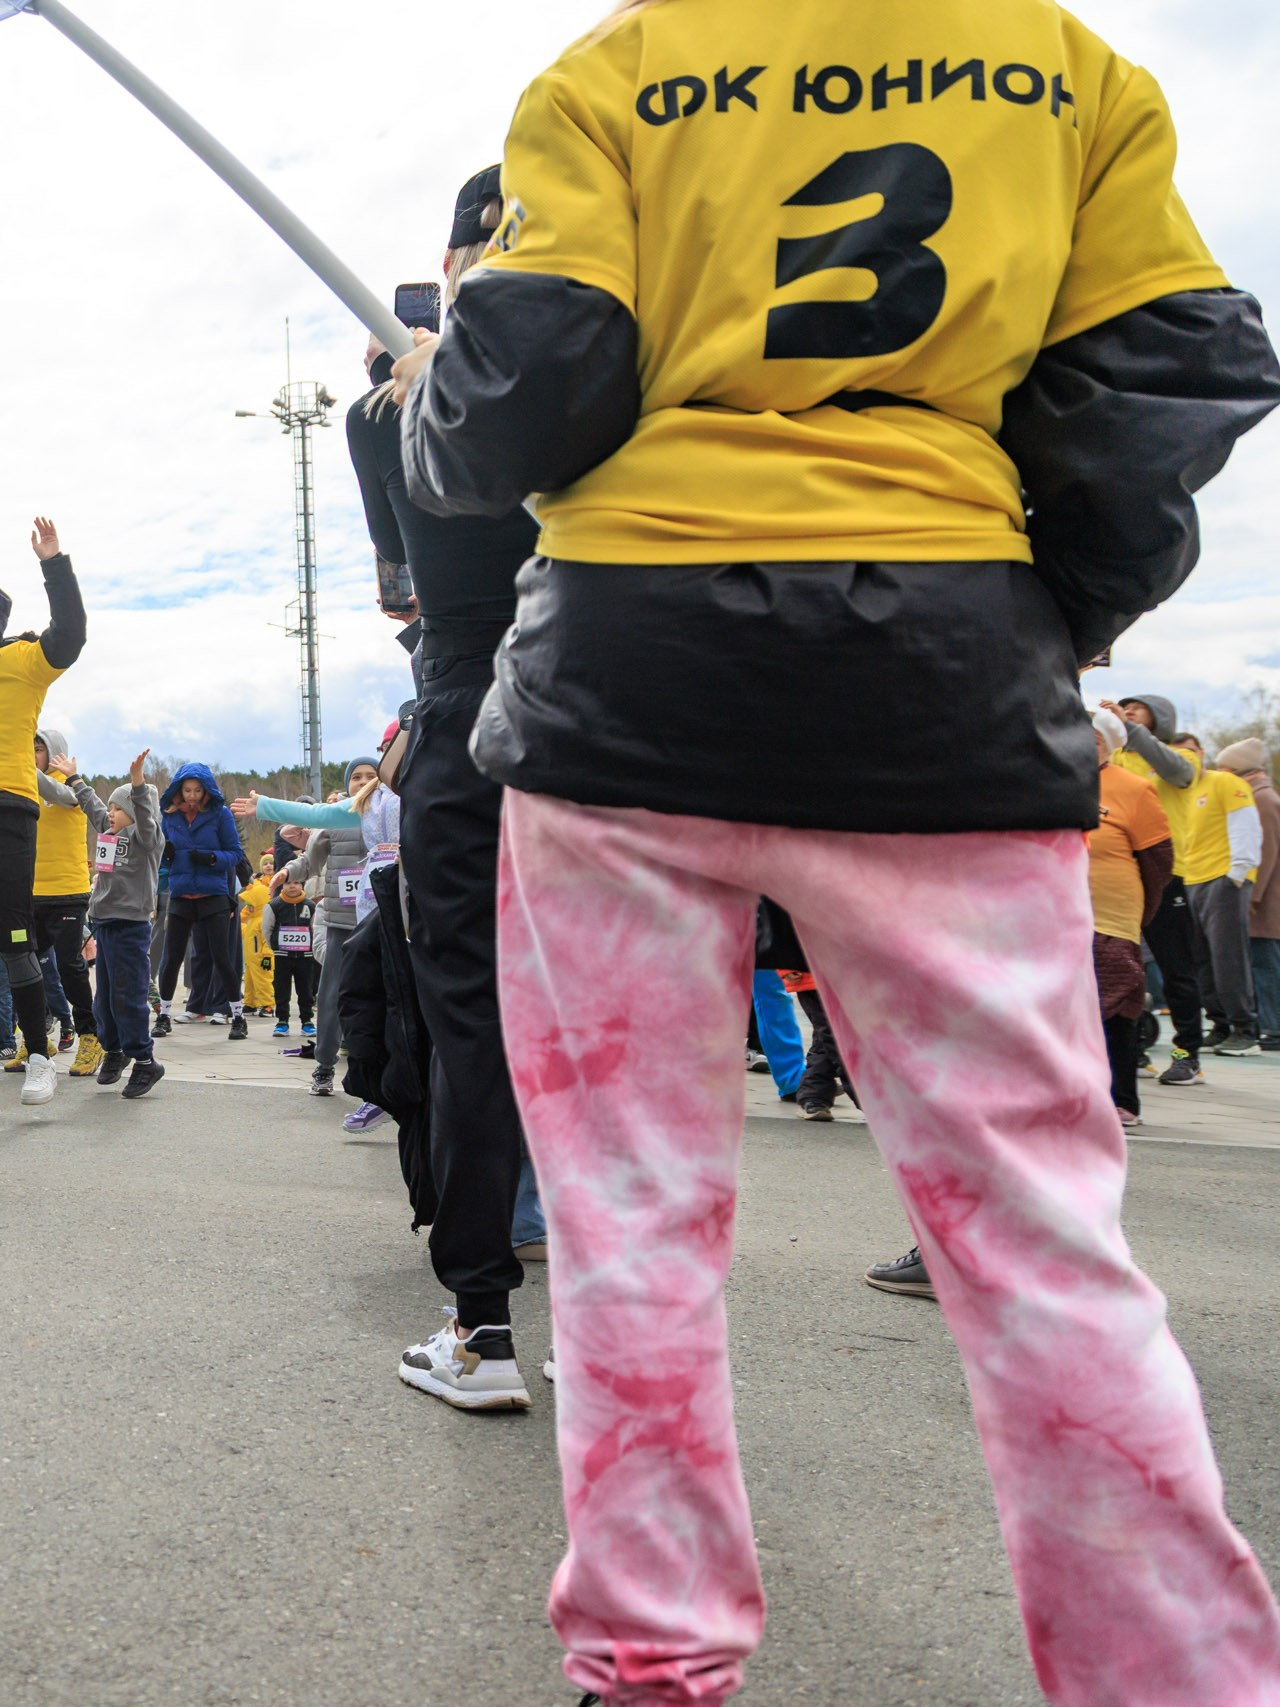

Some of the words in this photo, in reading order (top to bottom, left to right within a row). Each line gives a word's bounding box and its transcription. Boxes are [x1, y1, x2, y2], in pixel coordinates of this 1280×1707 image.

[635, 65, 769, 126] ФК
[793, 57, 1078, 127] ЮНИОН
[763, 141, 954, 360] 3
[282, 934, 307, 943] 5220
